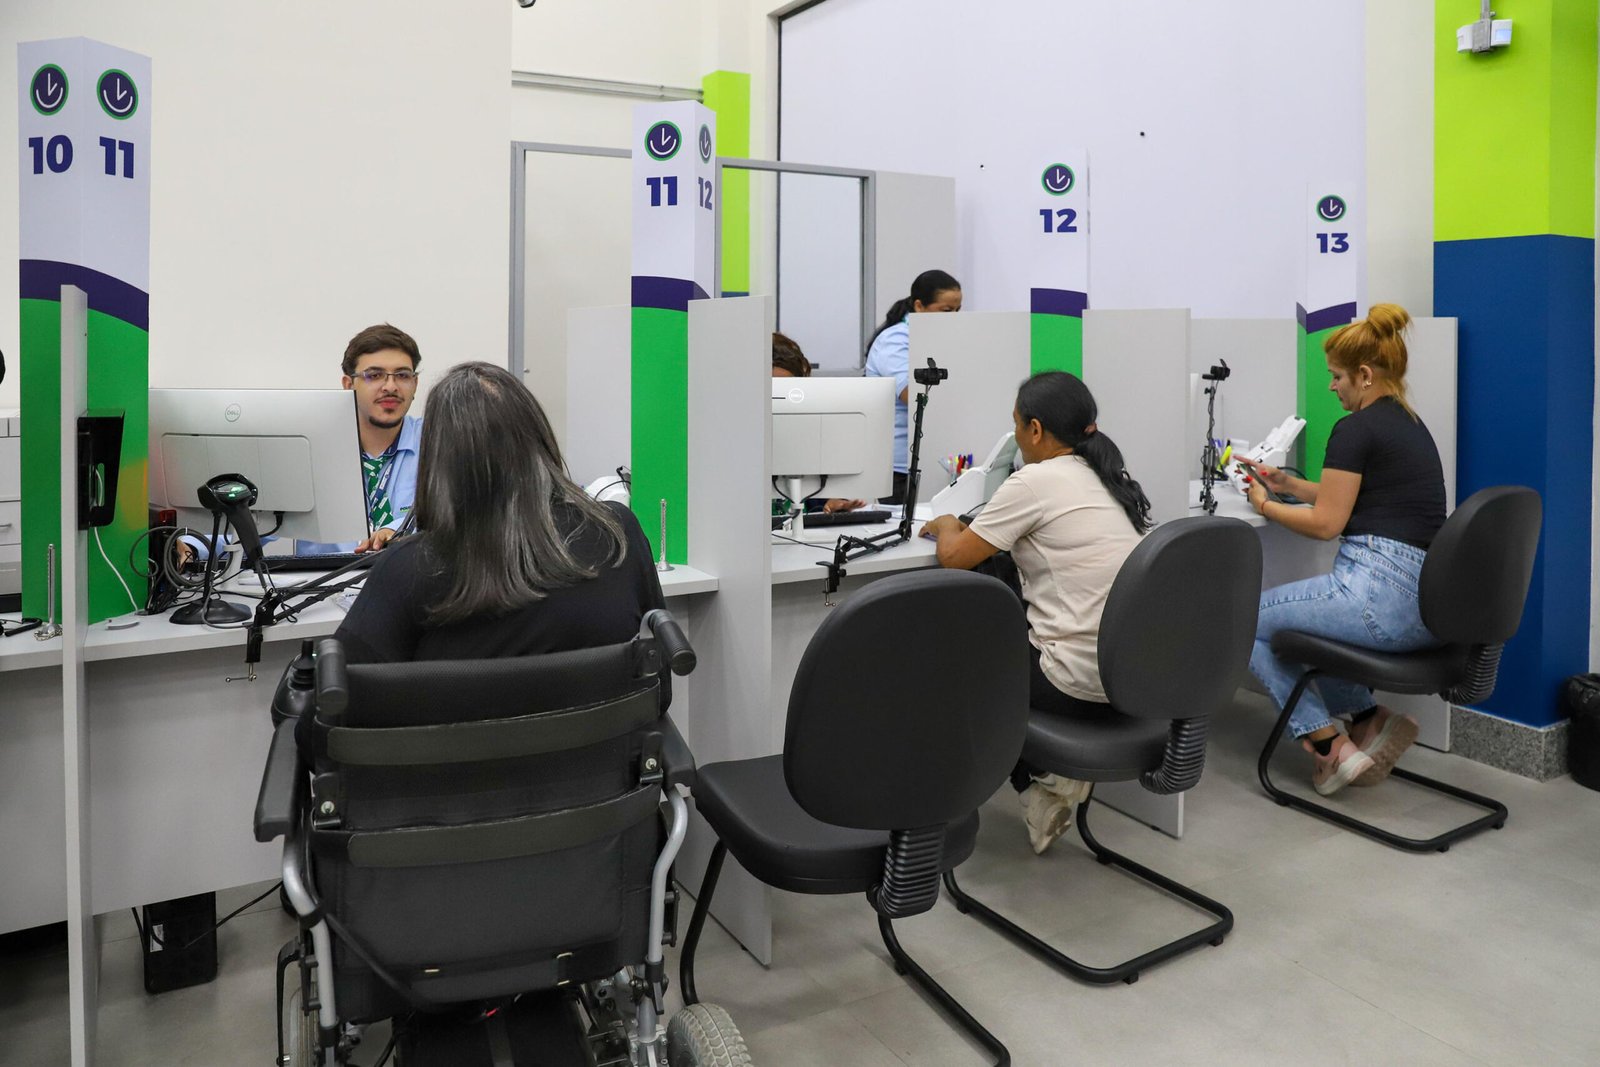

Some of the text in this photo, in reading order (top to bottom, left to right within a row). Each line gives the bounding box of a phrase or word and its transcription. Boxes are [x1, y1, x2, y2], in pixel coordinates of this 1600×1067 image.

[28, 135, 73, 175] 10
[99, 136, 134, 179] 11
[646, 176, 677, 206] 11
[697, 177, 713, 210] 12
[1040, 208, 1077, 233] 12
[1316, 233, 1350, 254] 13
